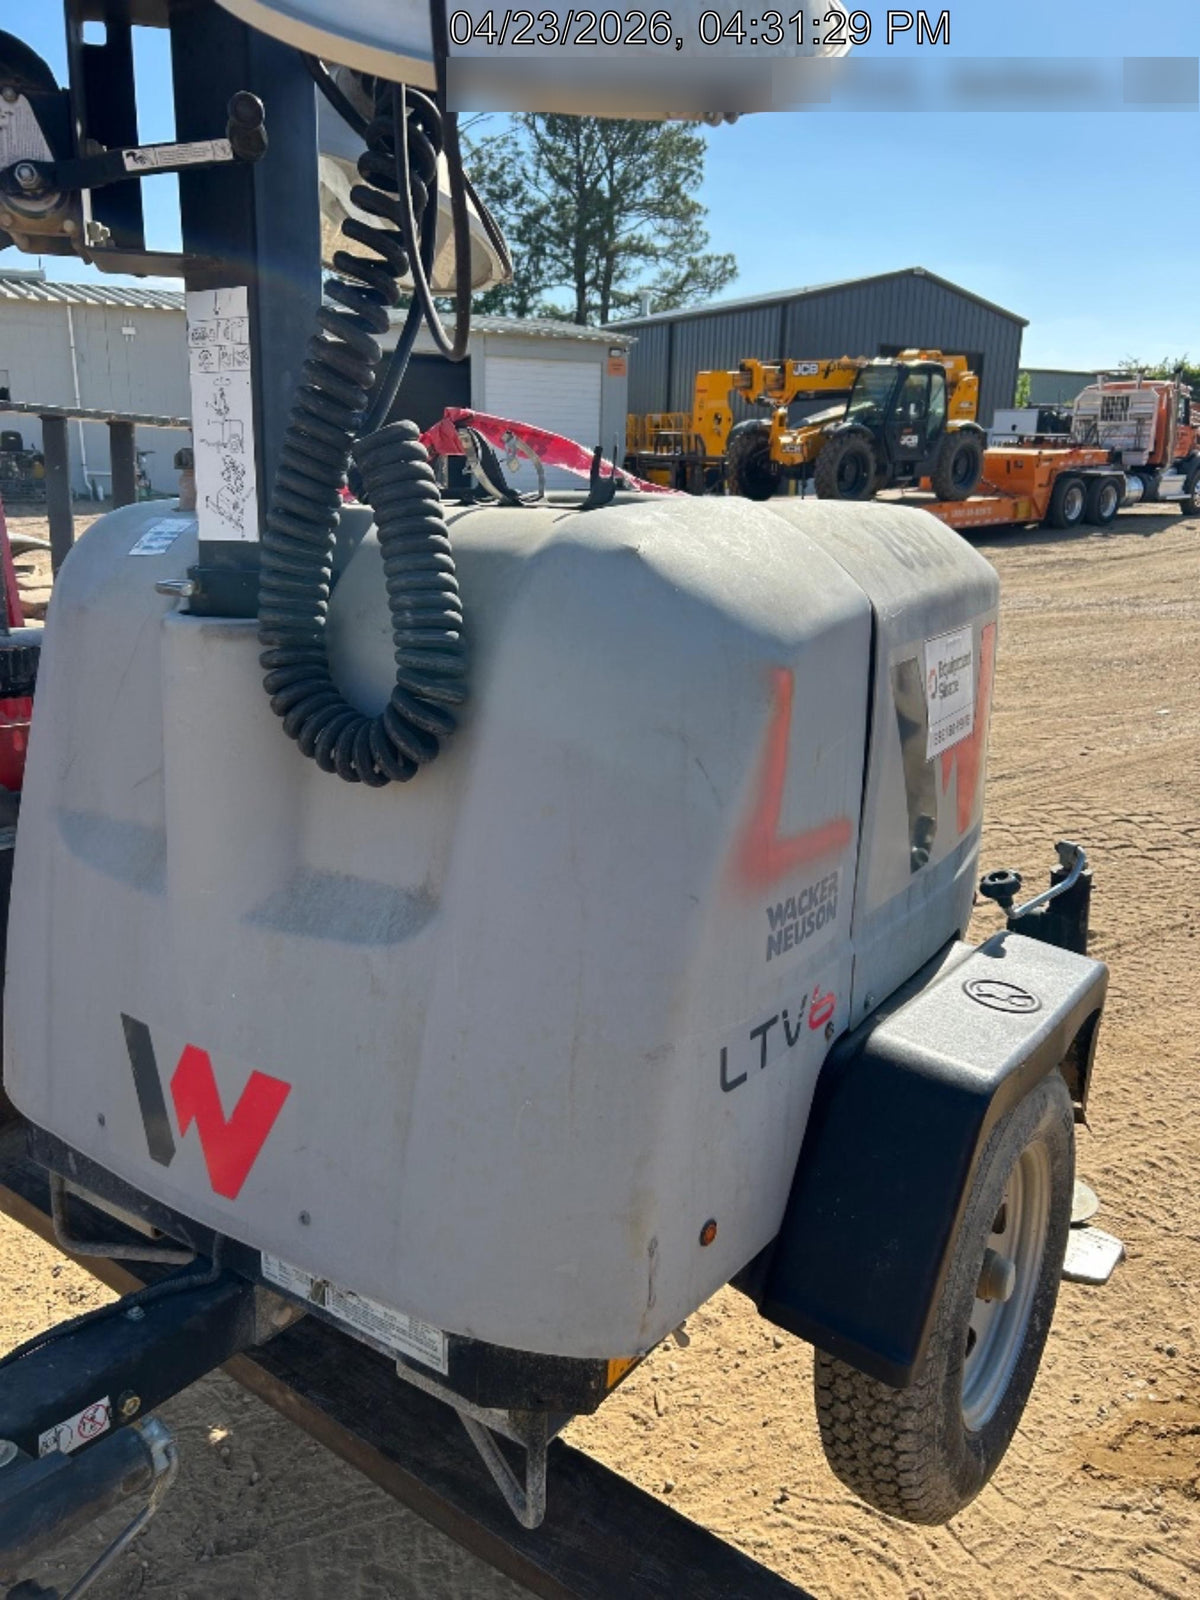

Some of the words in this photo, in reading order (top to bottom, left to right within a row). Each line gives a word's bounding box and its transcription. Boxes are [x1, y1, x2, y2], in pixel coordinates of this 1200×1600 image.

[793, 363, 818, 375] JCB
[900, 435, 918, 447] JCB
[766, 871, 838, 931] WACKER
[766, 896, 838, 962] NEUSON
[720, 984, 836, 1093] LTV6
